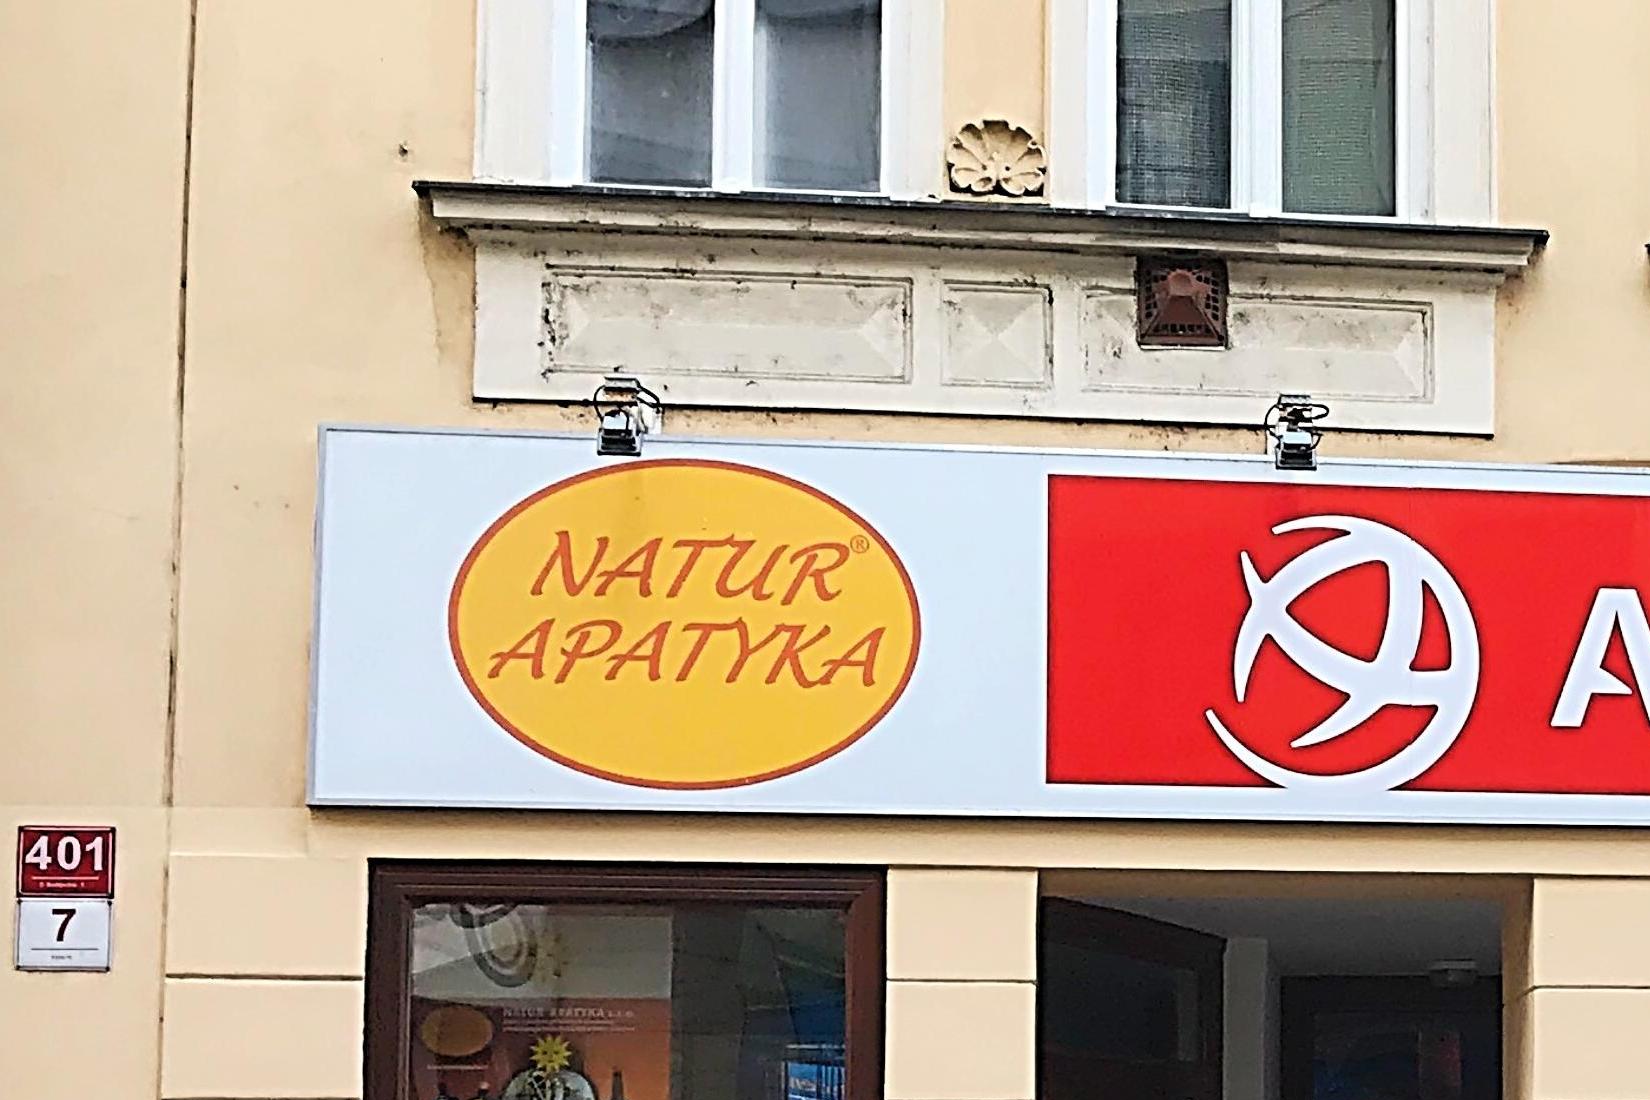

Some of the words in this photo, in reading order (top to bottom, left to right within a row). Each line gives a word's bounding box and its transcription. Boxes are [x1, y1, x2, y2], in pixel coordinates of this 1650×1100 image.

[488, 617, 886, 690] APATYKA
[25, 835, 103, 871] 401
[52, 908, 76, 942] 7
